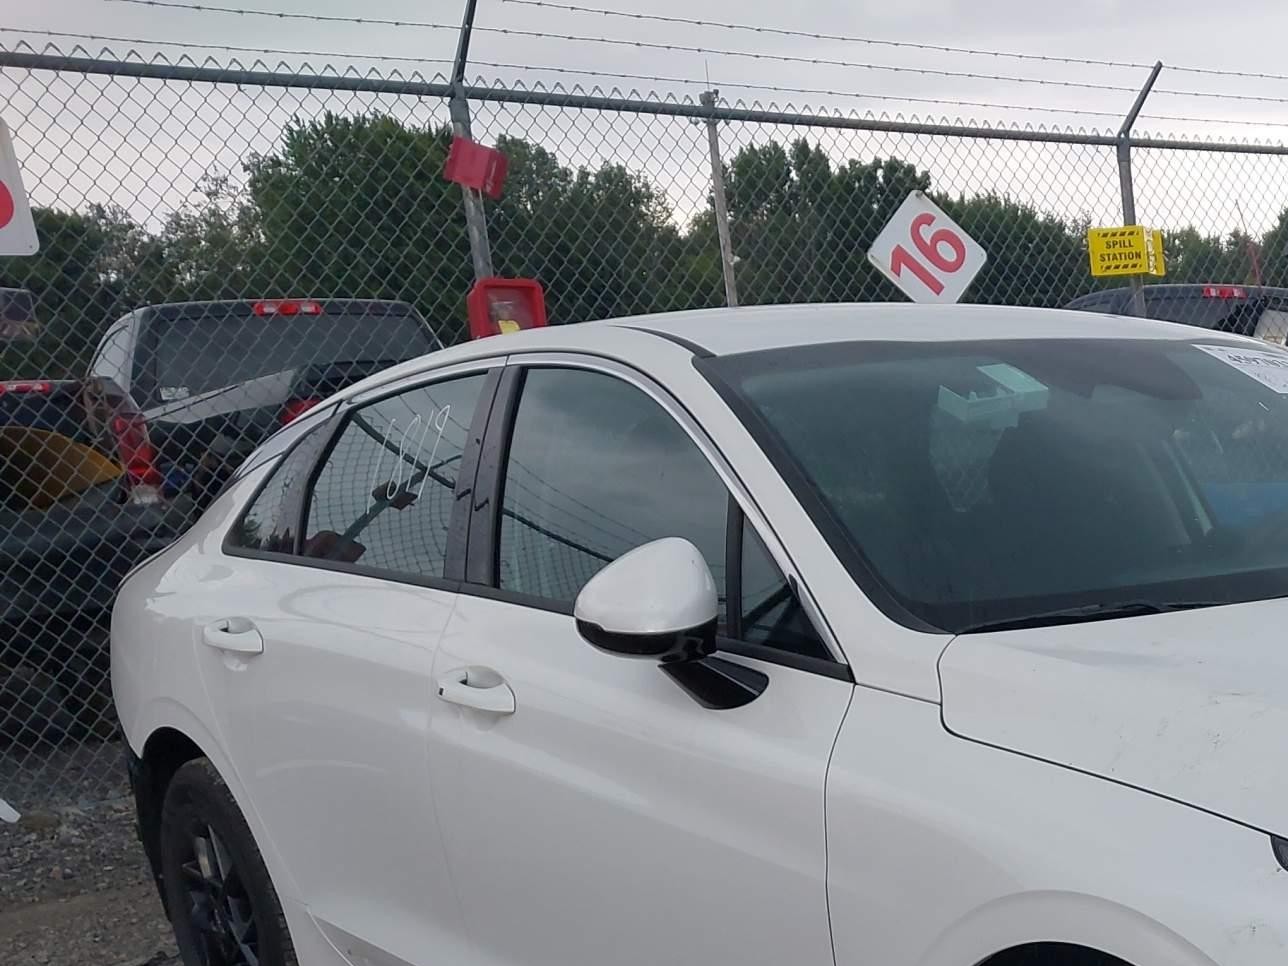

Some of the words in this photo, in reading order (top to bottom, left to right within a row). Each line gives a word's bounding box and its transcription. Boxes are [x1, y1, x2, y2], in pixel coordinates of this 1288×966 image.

[1105, 239, 1134, 249] SPILL
[890, 212, 966, 296] 16
[1099, 251, 1141, 262] STATION
